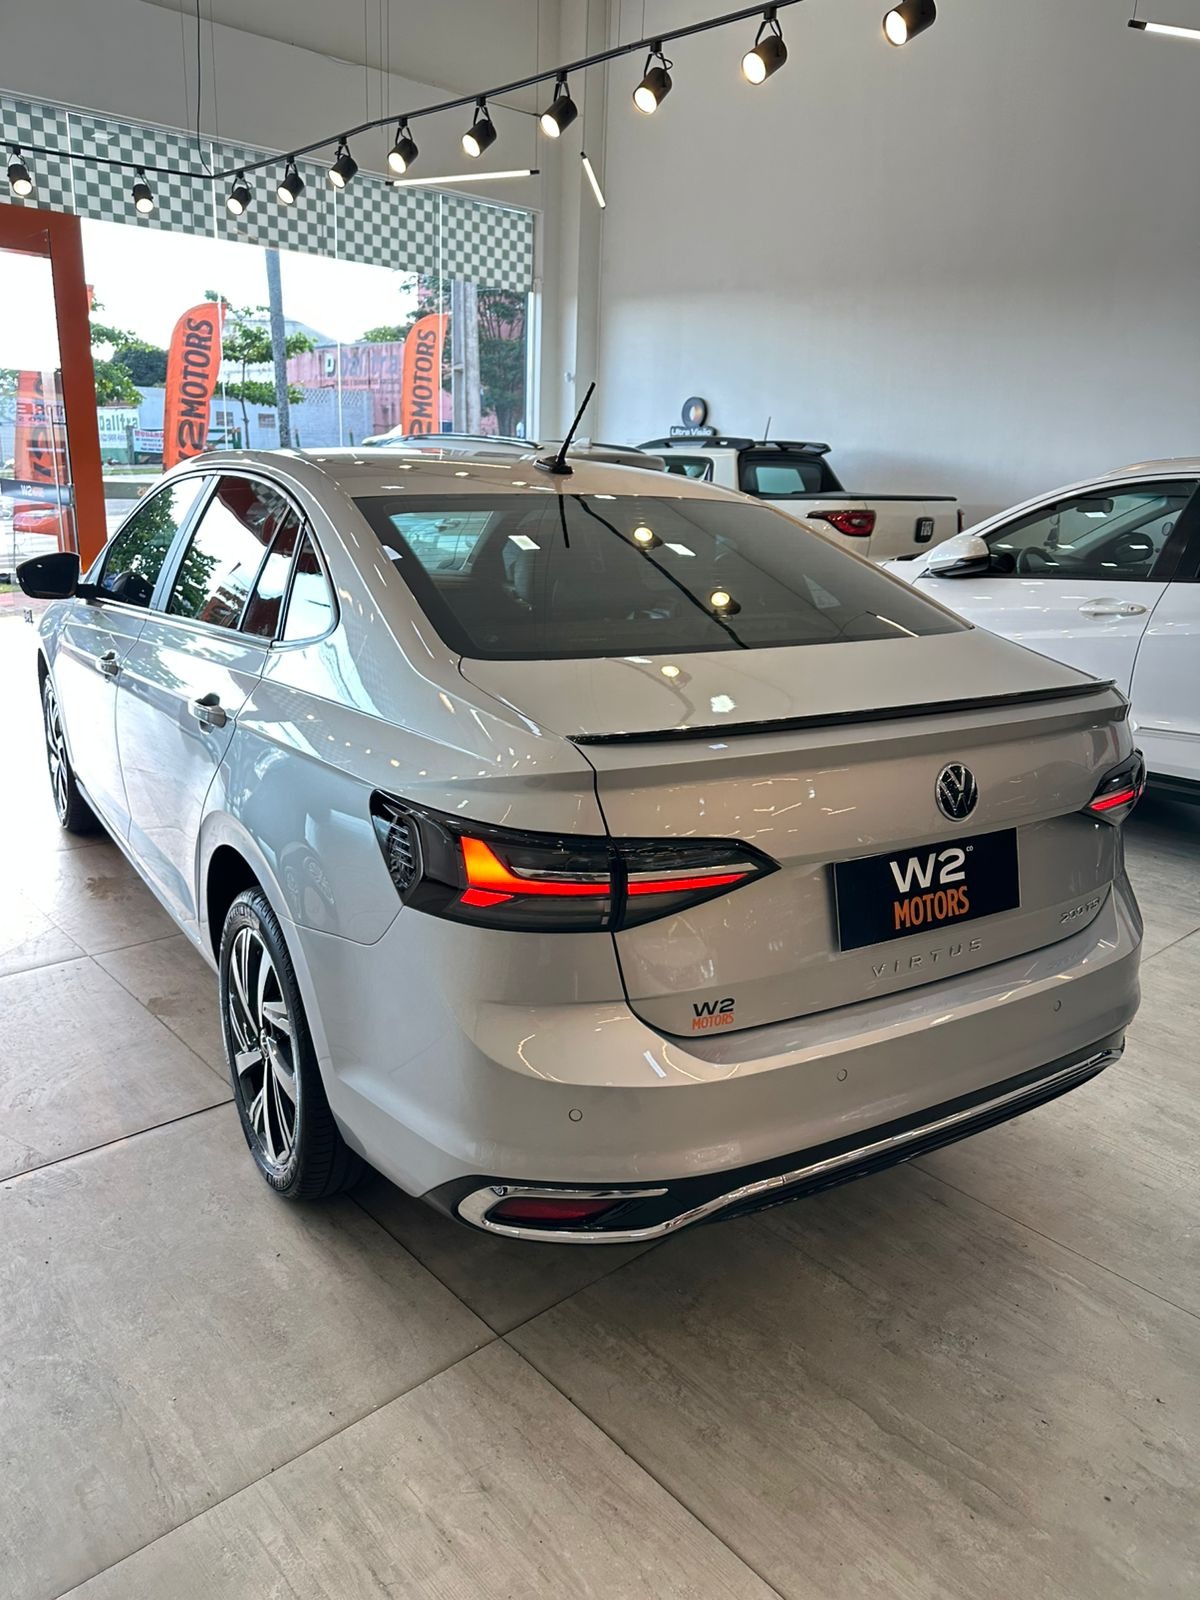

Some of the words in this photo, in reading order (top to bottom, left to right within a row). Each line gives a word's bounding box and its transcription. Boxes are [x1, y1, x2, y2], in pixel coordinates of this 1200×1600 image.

[889, 848, 966, 893] W2
[893, 885, 970, 930] MOTORS
[872, 937, 983, 978] VIRTUS
[691, 1013, 736, 1031] MOTORS
[692, 998, 735, 1017] W2
